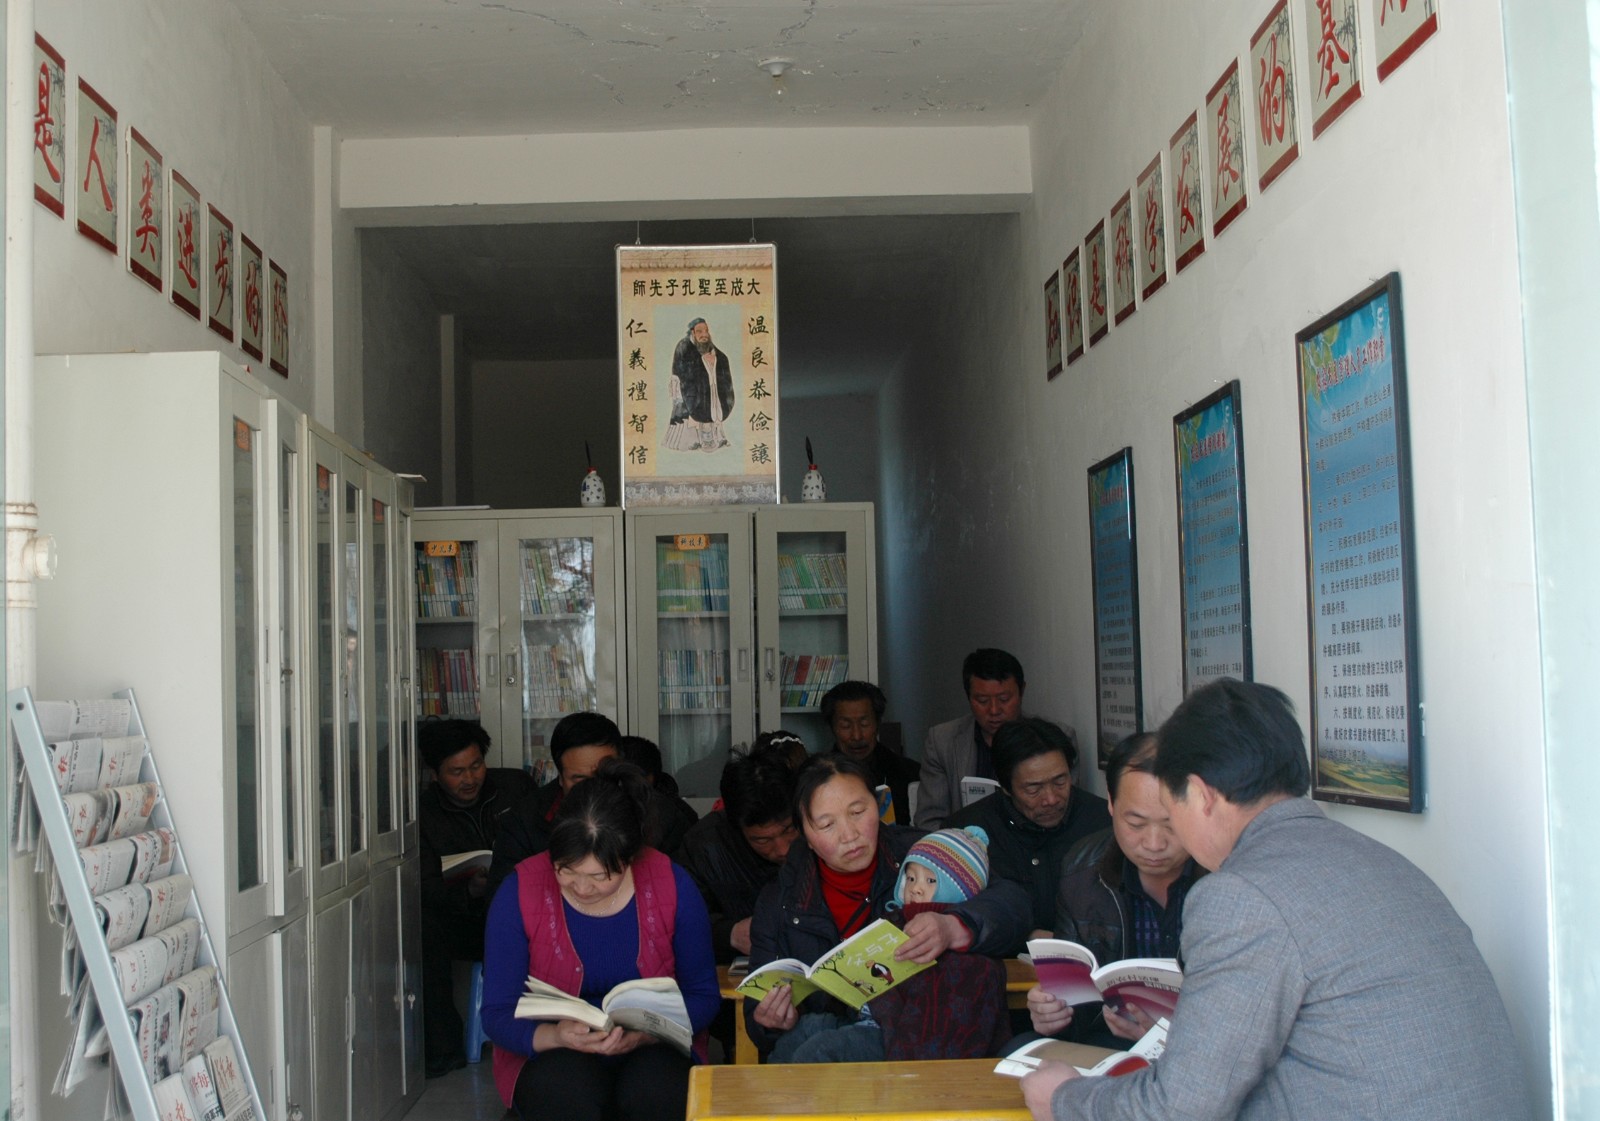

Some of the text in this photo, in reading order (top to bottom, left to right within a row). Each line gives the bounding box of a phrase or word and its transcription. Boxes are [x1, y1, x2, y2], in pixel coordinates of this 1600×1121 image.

[1259, 33, 1285, 146] 的
[84, 116, 113, 212] 人
[626, 318, 648, 465] 仁義禮智信
